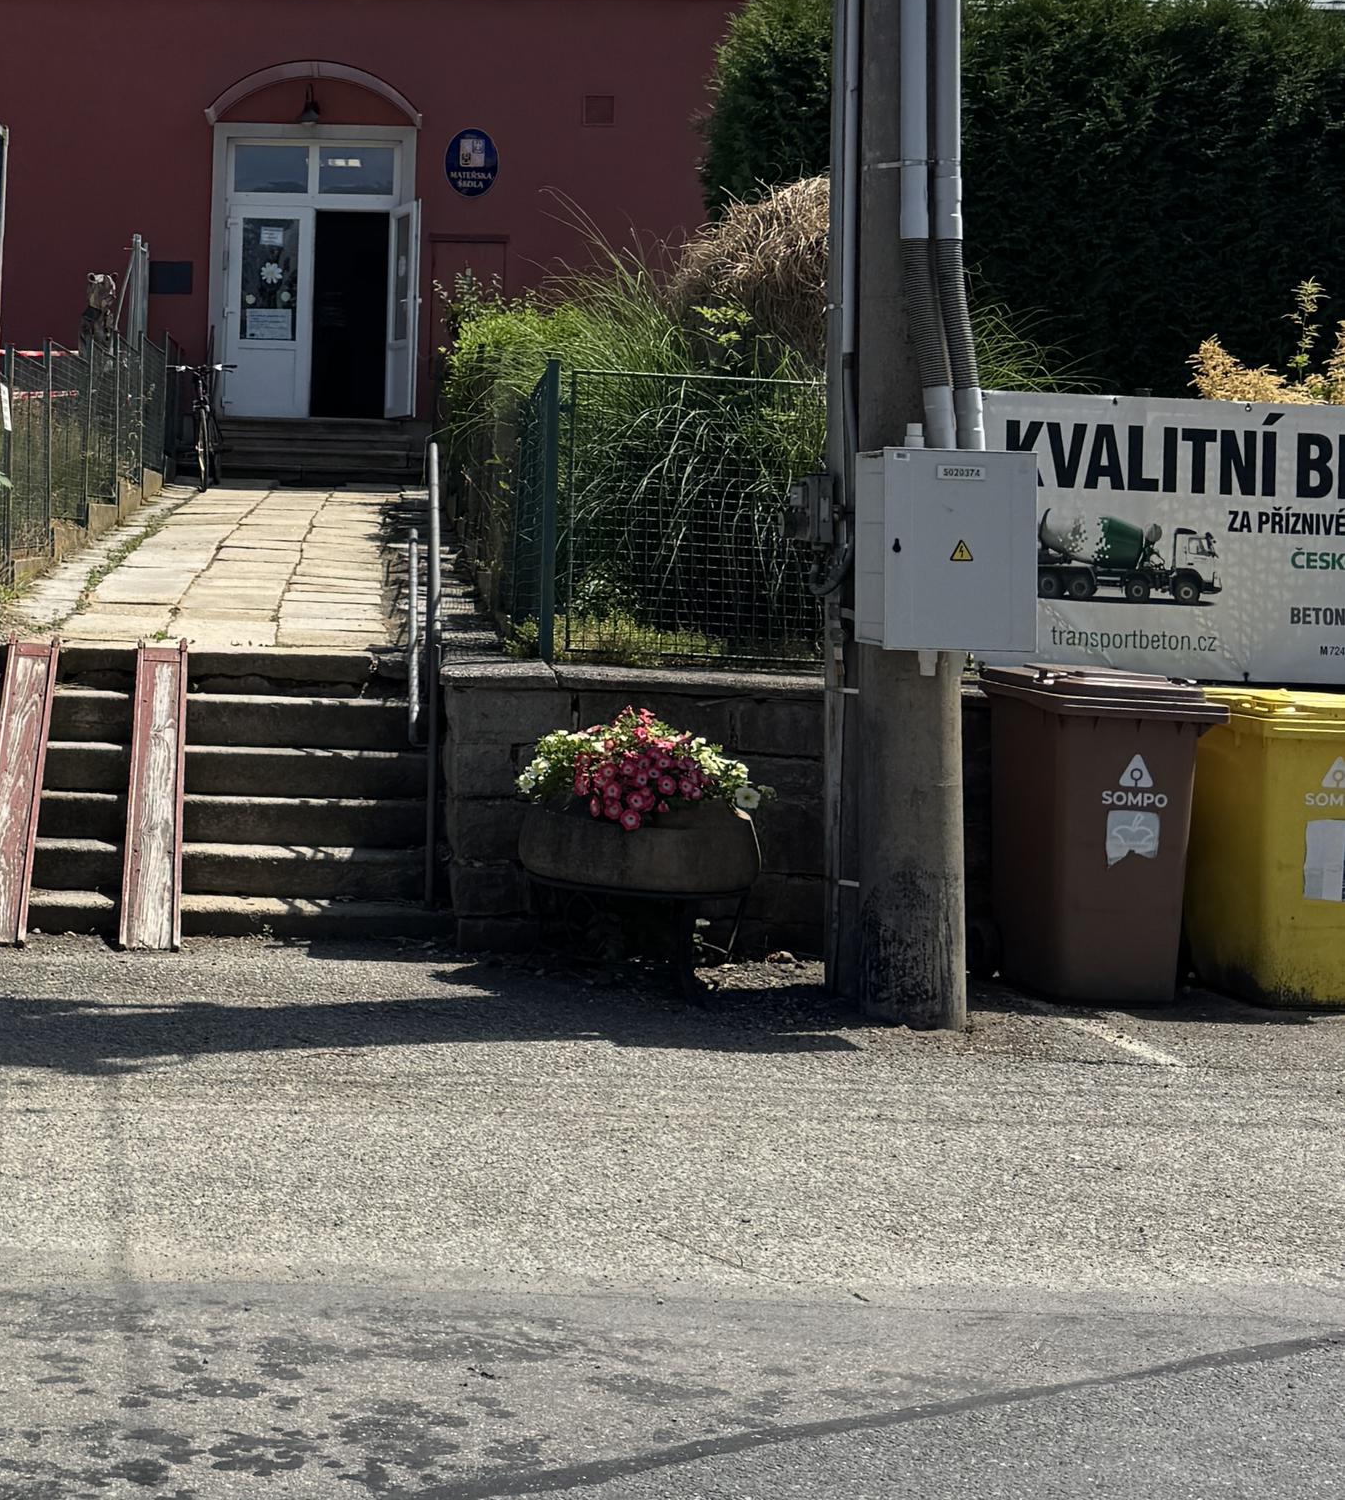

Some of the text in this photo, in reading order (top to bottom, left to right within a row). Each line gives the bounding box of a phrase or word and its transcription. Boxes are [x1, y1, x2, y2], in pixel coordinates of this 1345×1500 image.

[1228, 506, 1345, 536] ZA PŘÍZNIVÉ
[1051, 625, 1217, 652] transportbeton.cz
[1101, 790, 1168, 808] SOMPO
